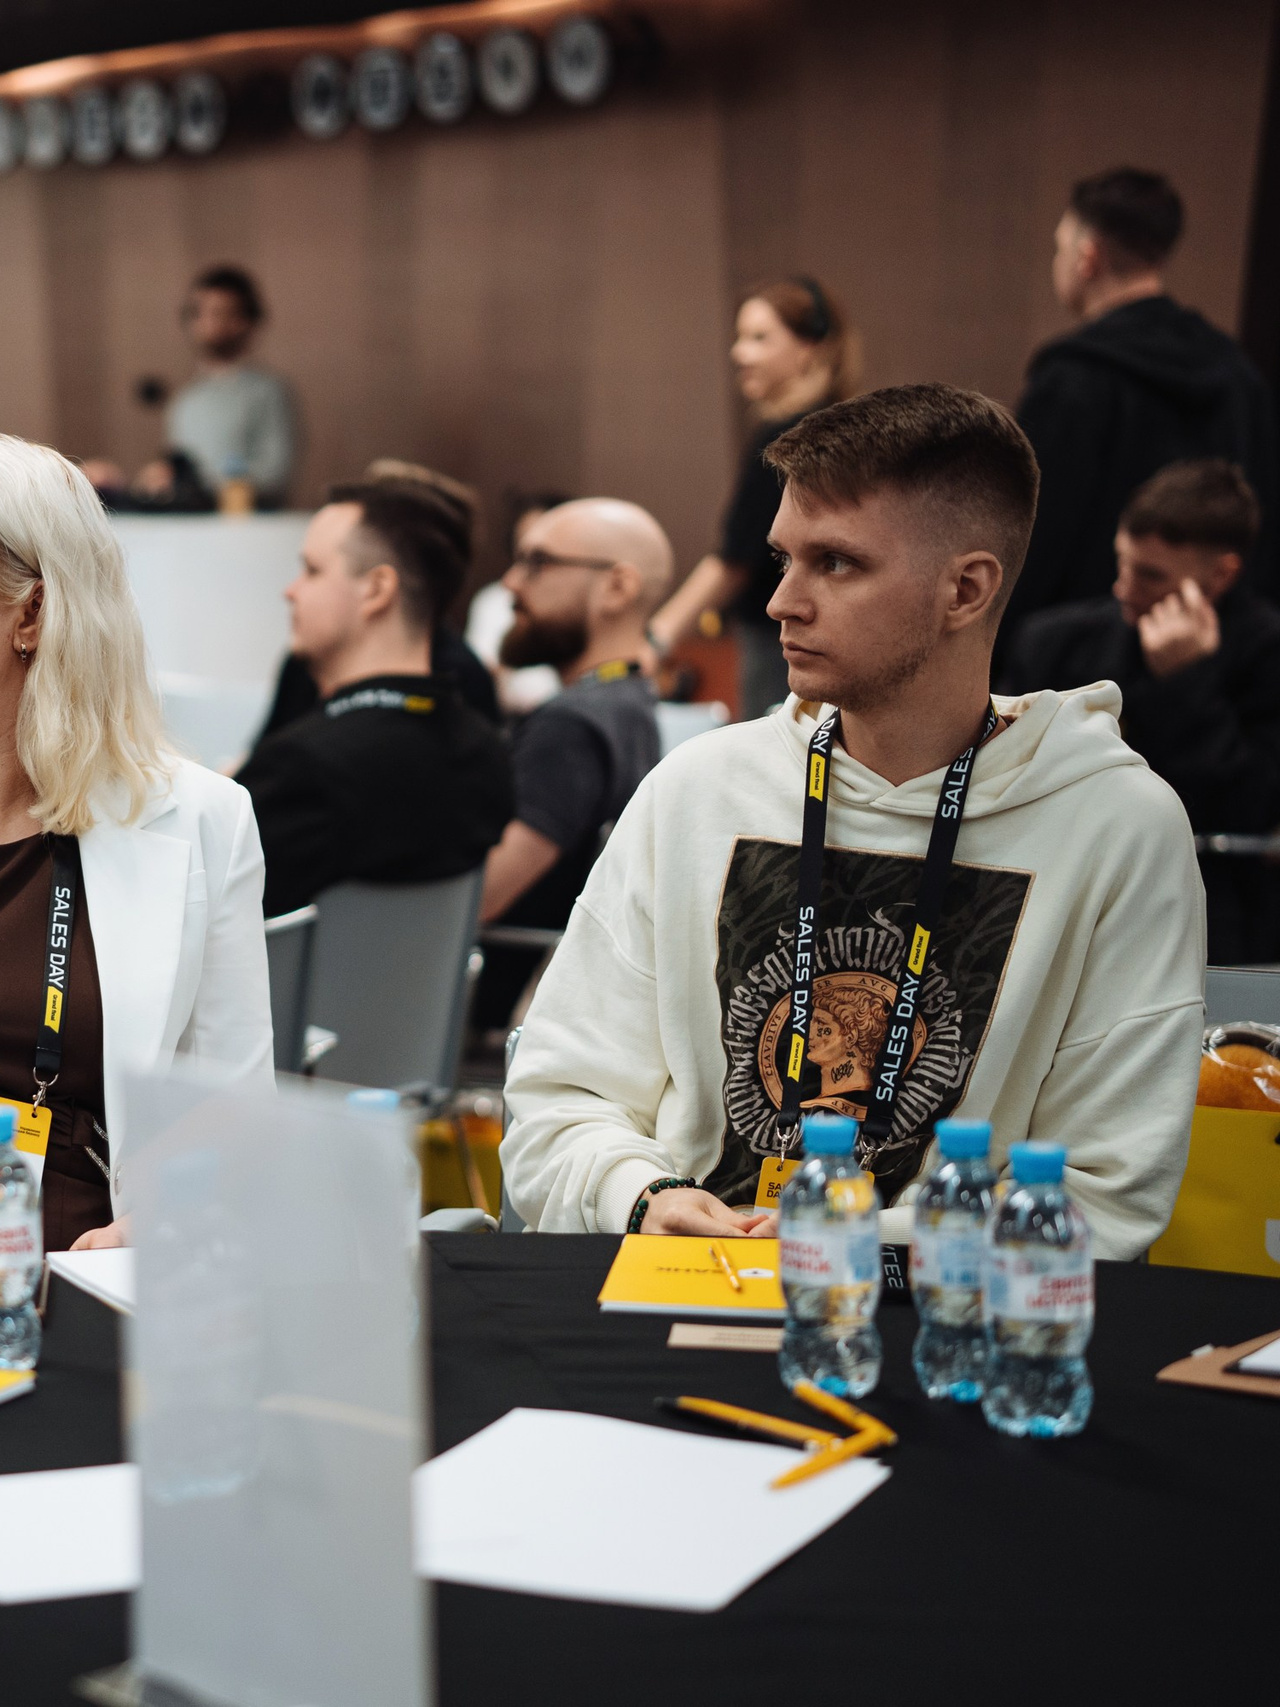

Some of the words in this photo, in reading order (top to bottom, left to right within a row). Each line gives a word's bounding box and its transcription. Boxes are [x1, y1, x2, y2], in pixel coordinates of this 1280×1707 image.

[813, 716, 836, 753] DAY
[941, 747, 974, 819] SALES
[51, 885, 71, 949] SALES
[795, 906, 814, 982] SALES
[48, 952, 66, 989] DAY
[763, 1013, 782, 1077] CLAVDIVS
[858, 977, 888, 992] AVG
[792, 989, 809, 1034] DAY
[875, 1025, 908, 1102] SALES
[896, 973, 920, 1018] DAY
[766, 1189, 782, 1199] DA
